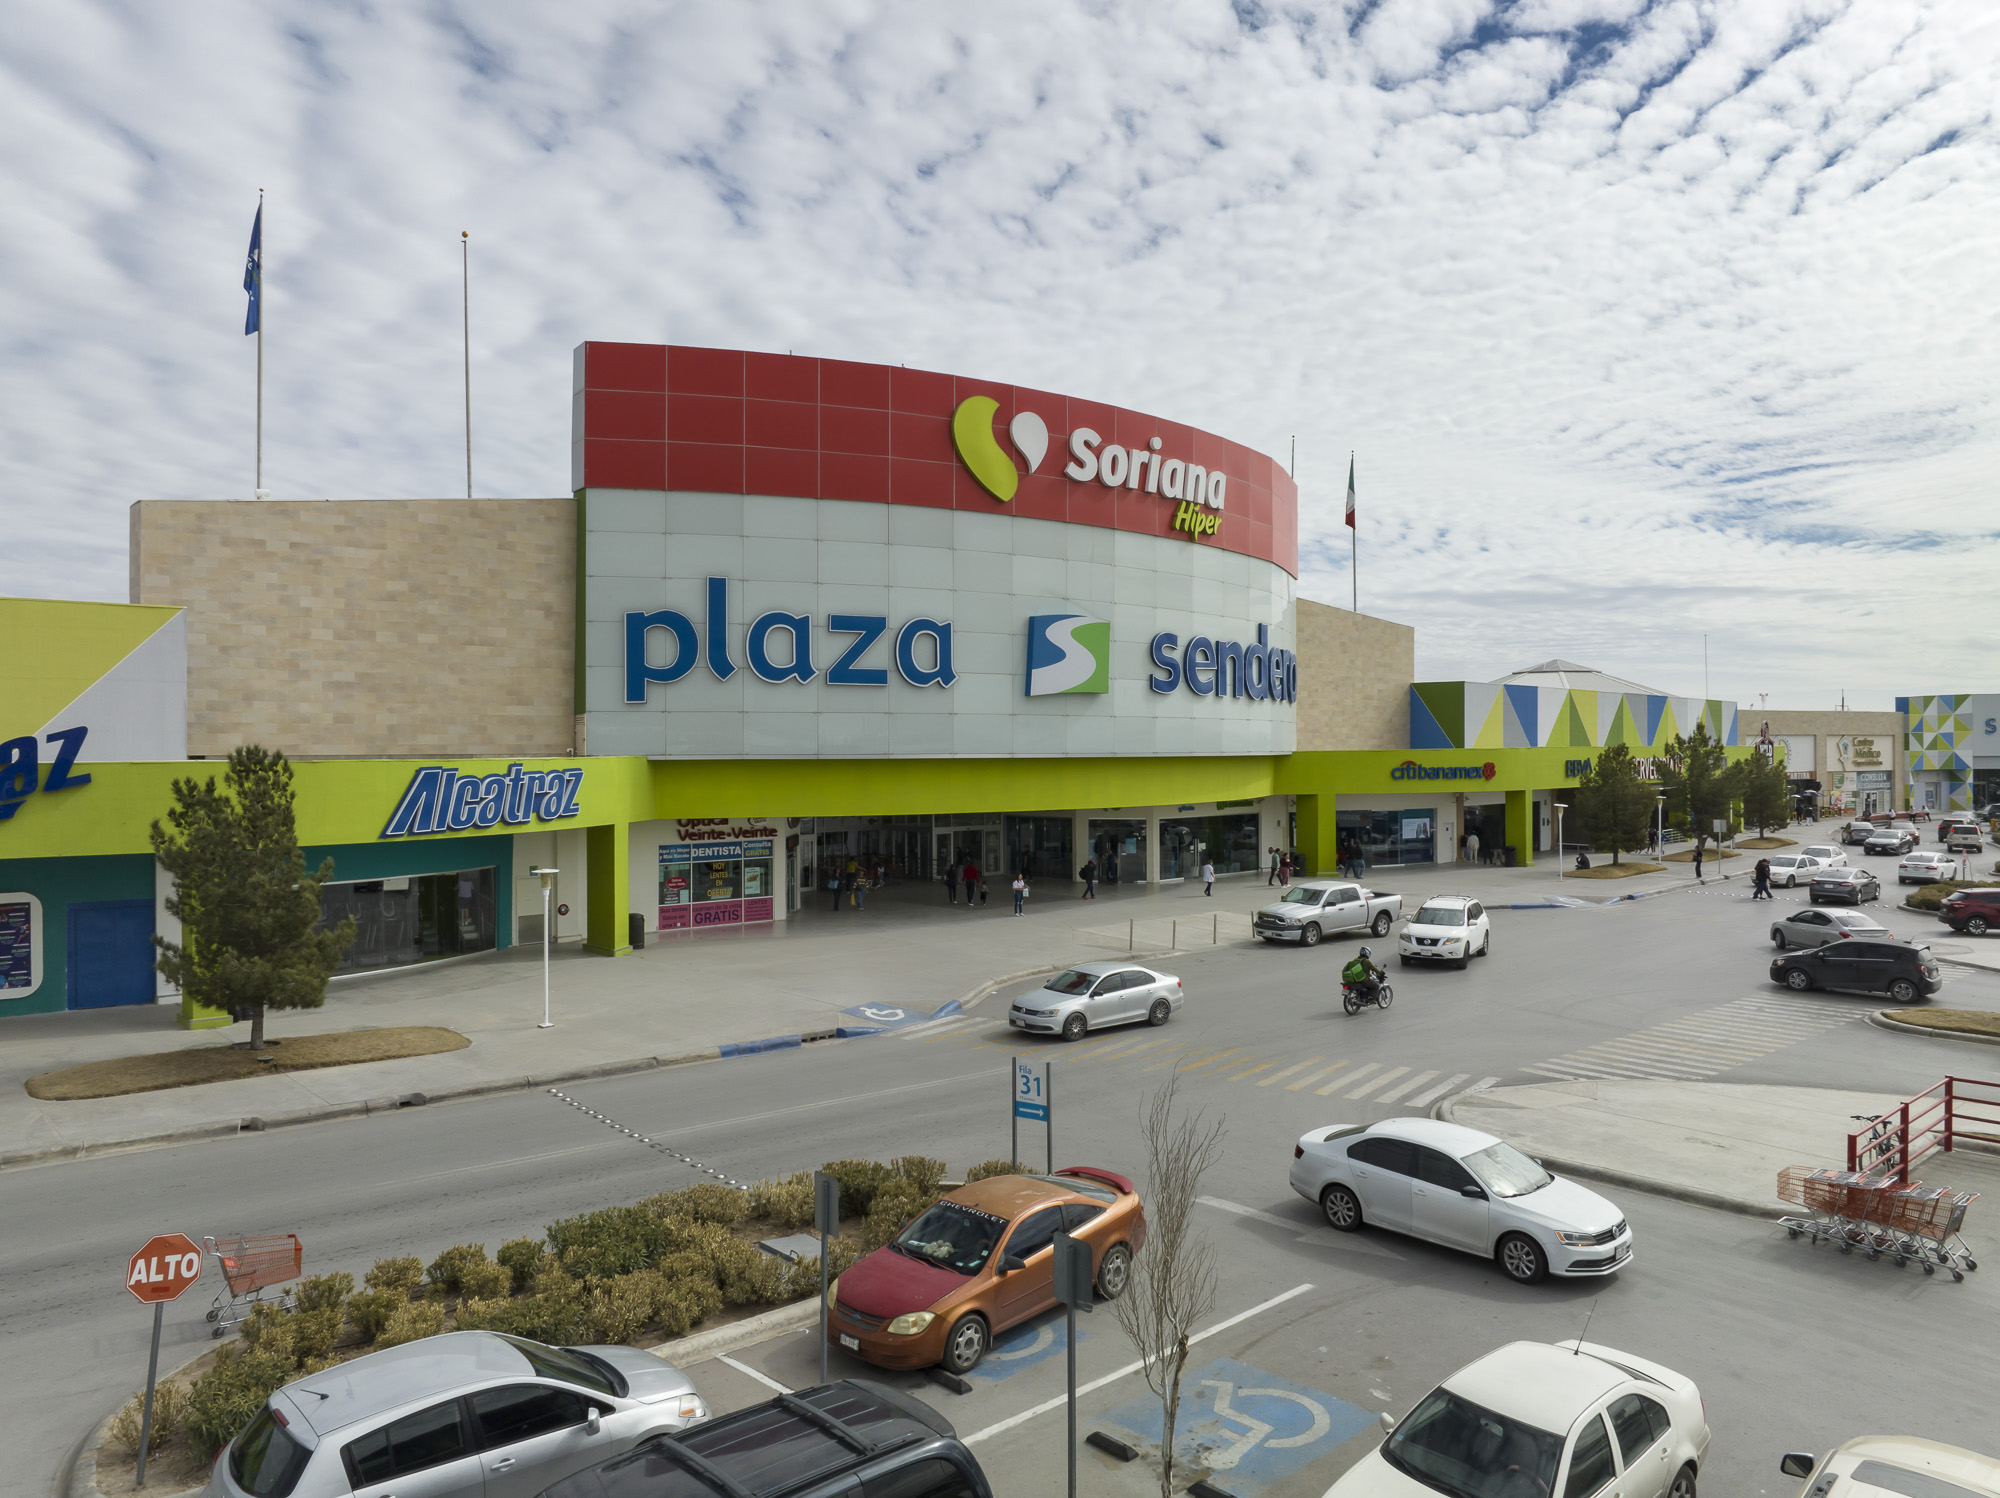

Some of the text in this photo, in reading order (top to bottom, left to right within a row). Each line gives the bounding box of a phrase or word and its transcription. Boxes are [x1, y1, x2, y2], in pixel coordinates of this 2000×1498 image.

[1064, 427, 1227, 510] Soriana
[1172, 501, 1222, 541] Hiper
[624, 576, 1297, 704] plaza sendero
[1391, 760, 1482, 780] citibanamex
[1566, 758, 1594, 778] BBVA
[378, 763, 585, 839] Alcatraz
[692, 846, 742, 858] DENTISTA
[743, 841, 772, 849] Consulta
[745, 849, 770, 857] GRATIS
[709, 871, 729, 879] LENTES
[712, 862, 725, 870] HOY
[707, 888, 731, 897] OFERTA
[694, 910, 739, 924] GRATIS
[1018, 1065, 1032, 1075] Fila
[1020, 1074, 1041, 1097] 31
[939, 1200, 1007, 1224] CHEVROLET
[128, 1252, 199, 1286] ALTO
